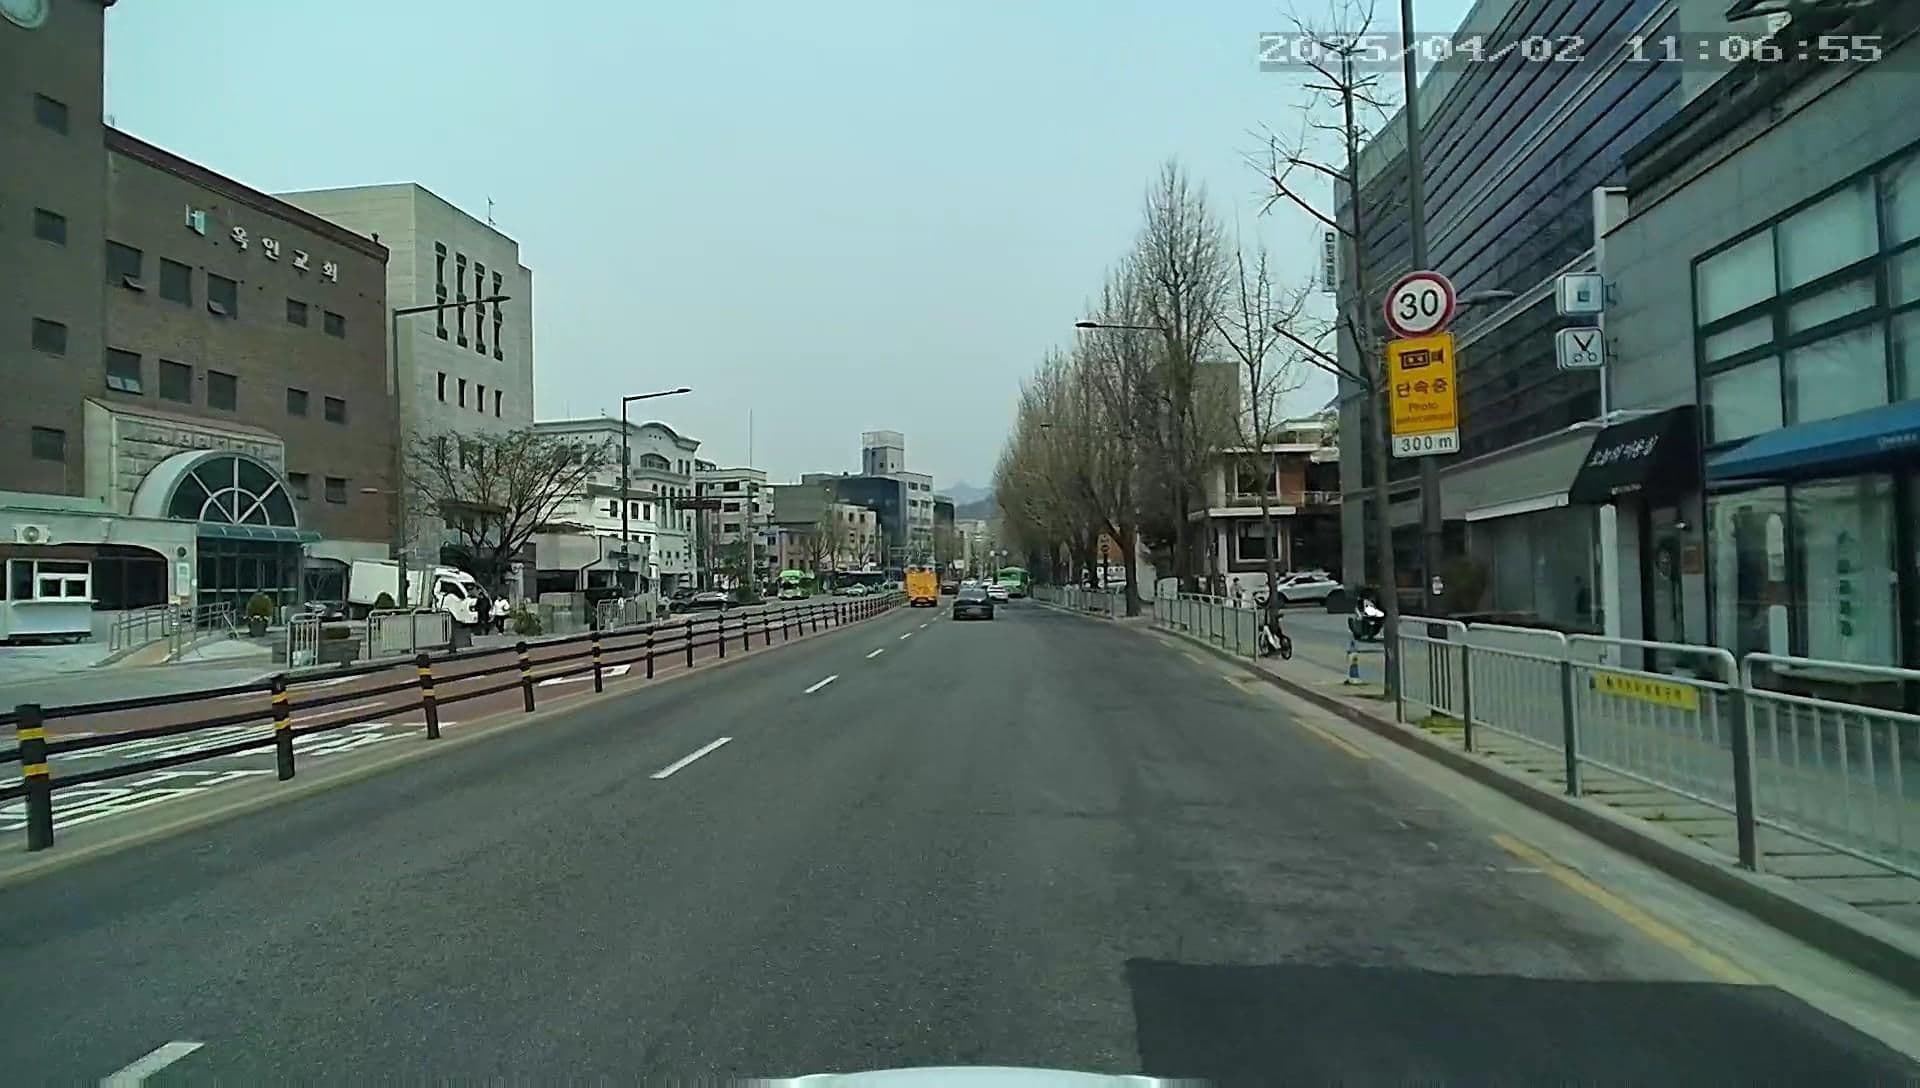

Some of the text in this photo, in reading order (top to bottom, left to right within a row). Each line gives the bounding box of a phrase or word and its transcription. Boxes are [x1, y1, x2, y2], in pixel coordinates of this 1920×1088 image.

[230, 226, 338, 283] 옥인교회
[1399, 288, 1439, 321] 30
[1396, 377, 1448, 398] 단속중
[1400, 435, 1453, 452] 300 m
